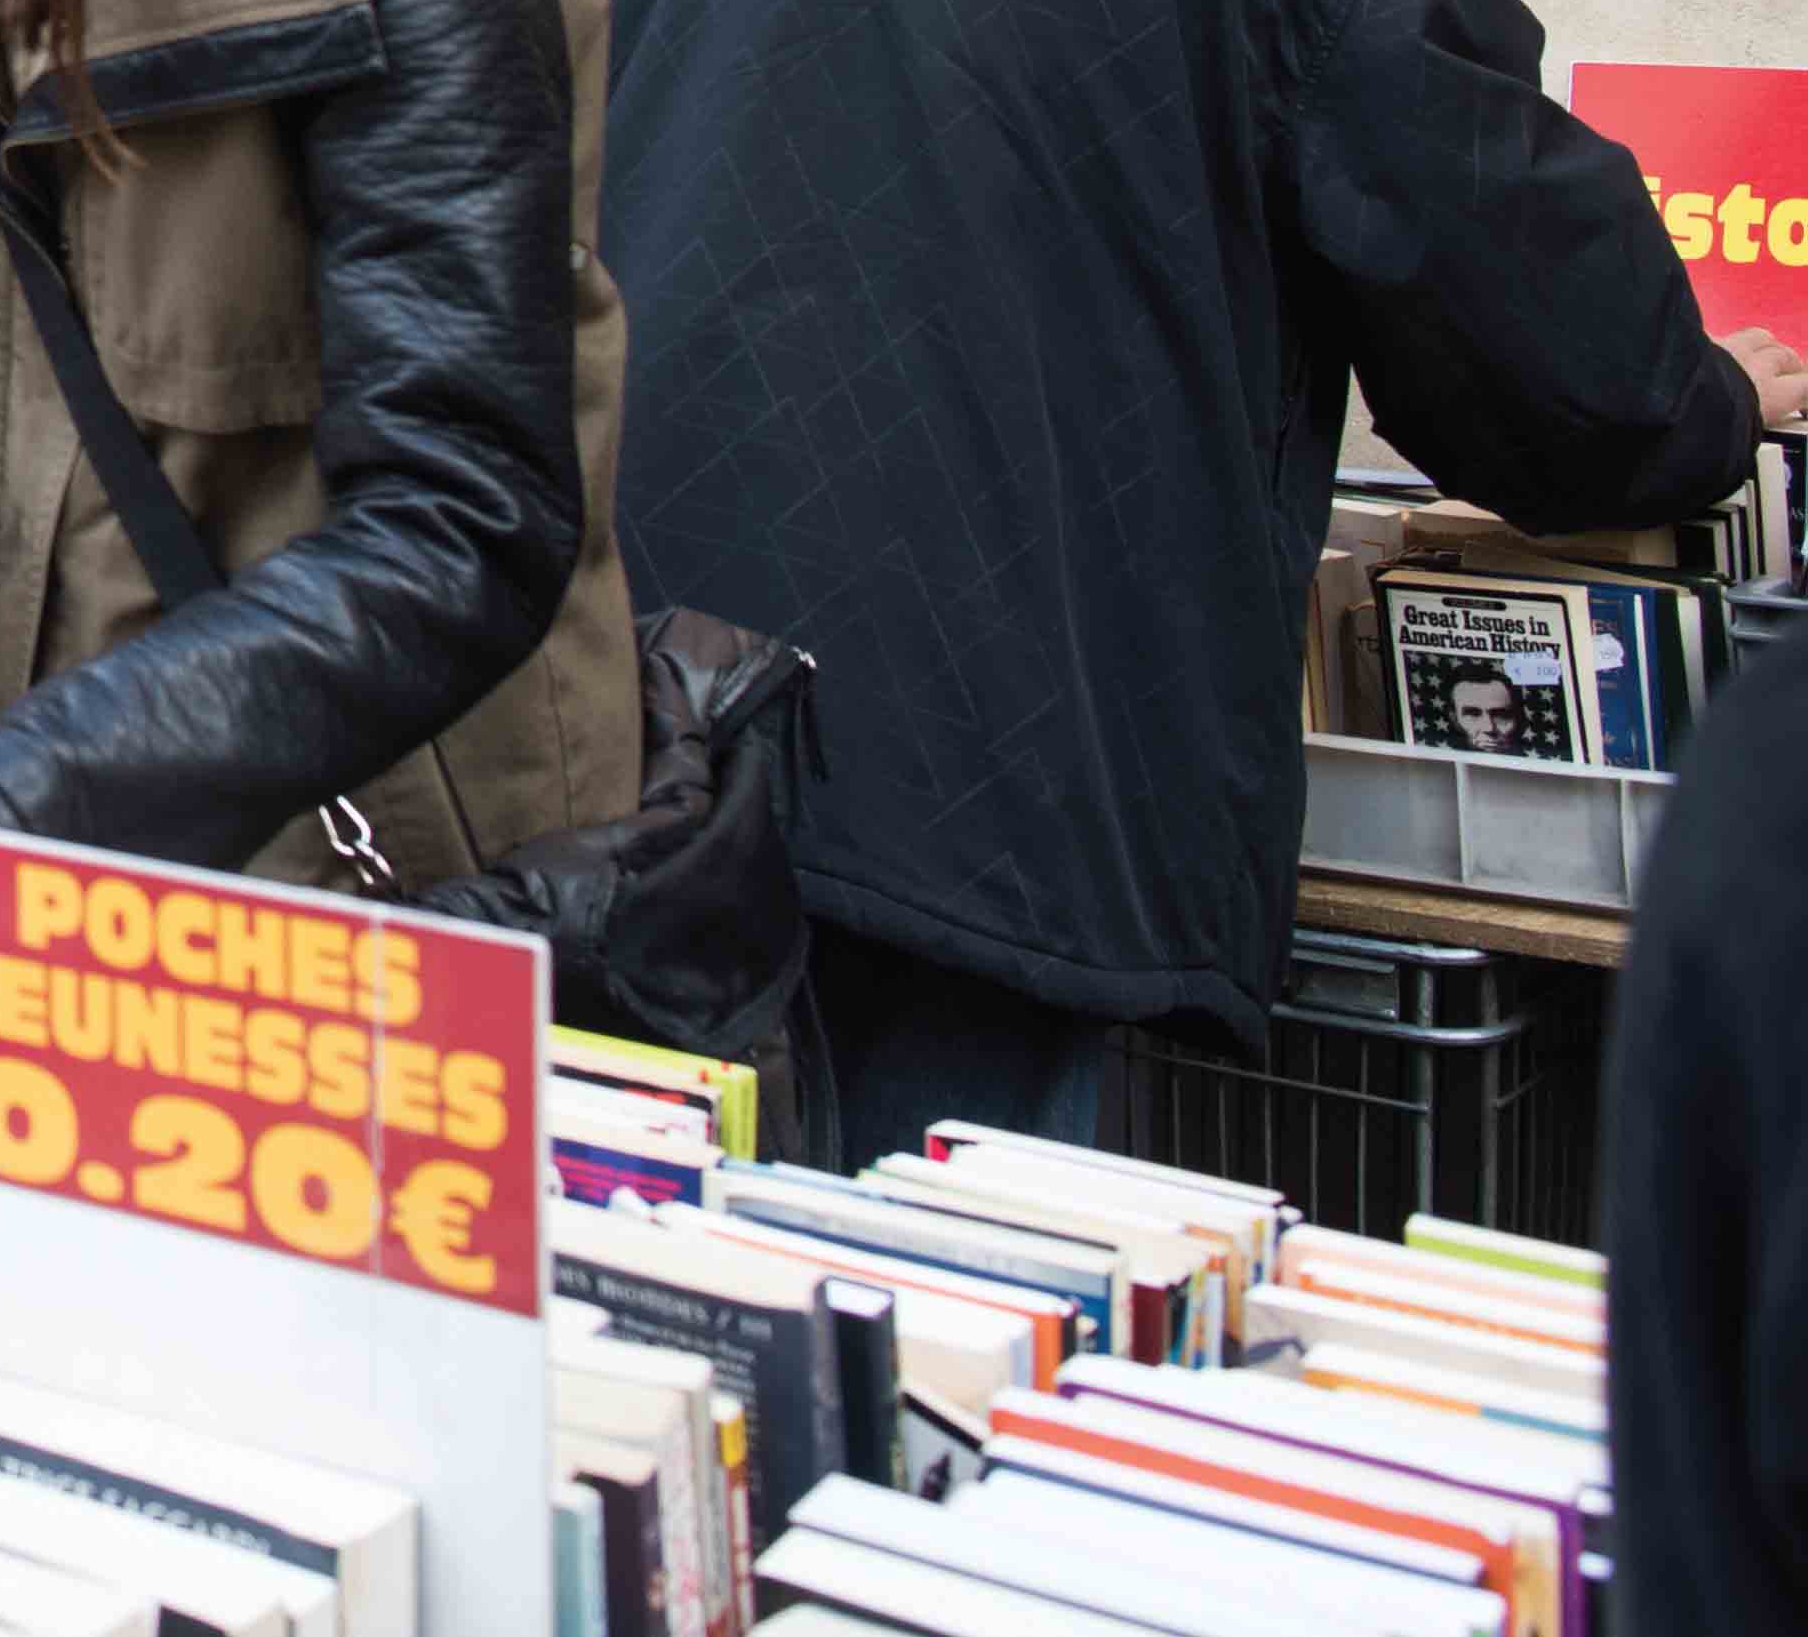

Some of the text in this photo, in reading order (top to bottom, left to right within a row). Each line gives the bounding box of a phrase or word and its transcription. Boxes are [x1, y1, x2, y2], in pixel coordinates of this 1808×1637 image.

[1402, 604, 1551, 637] Great Issues in
[1398, 624, 1490, 653] American
[14, 861, 423, 1030] POCHES
